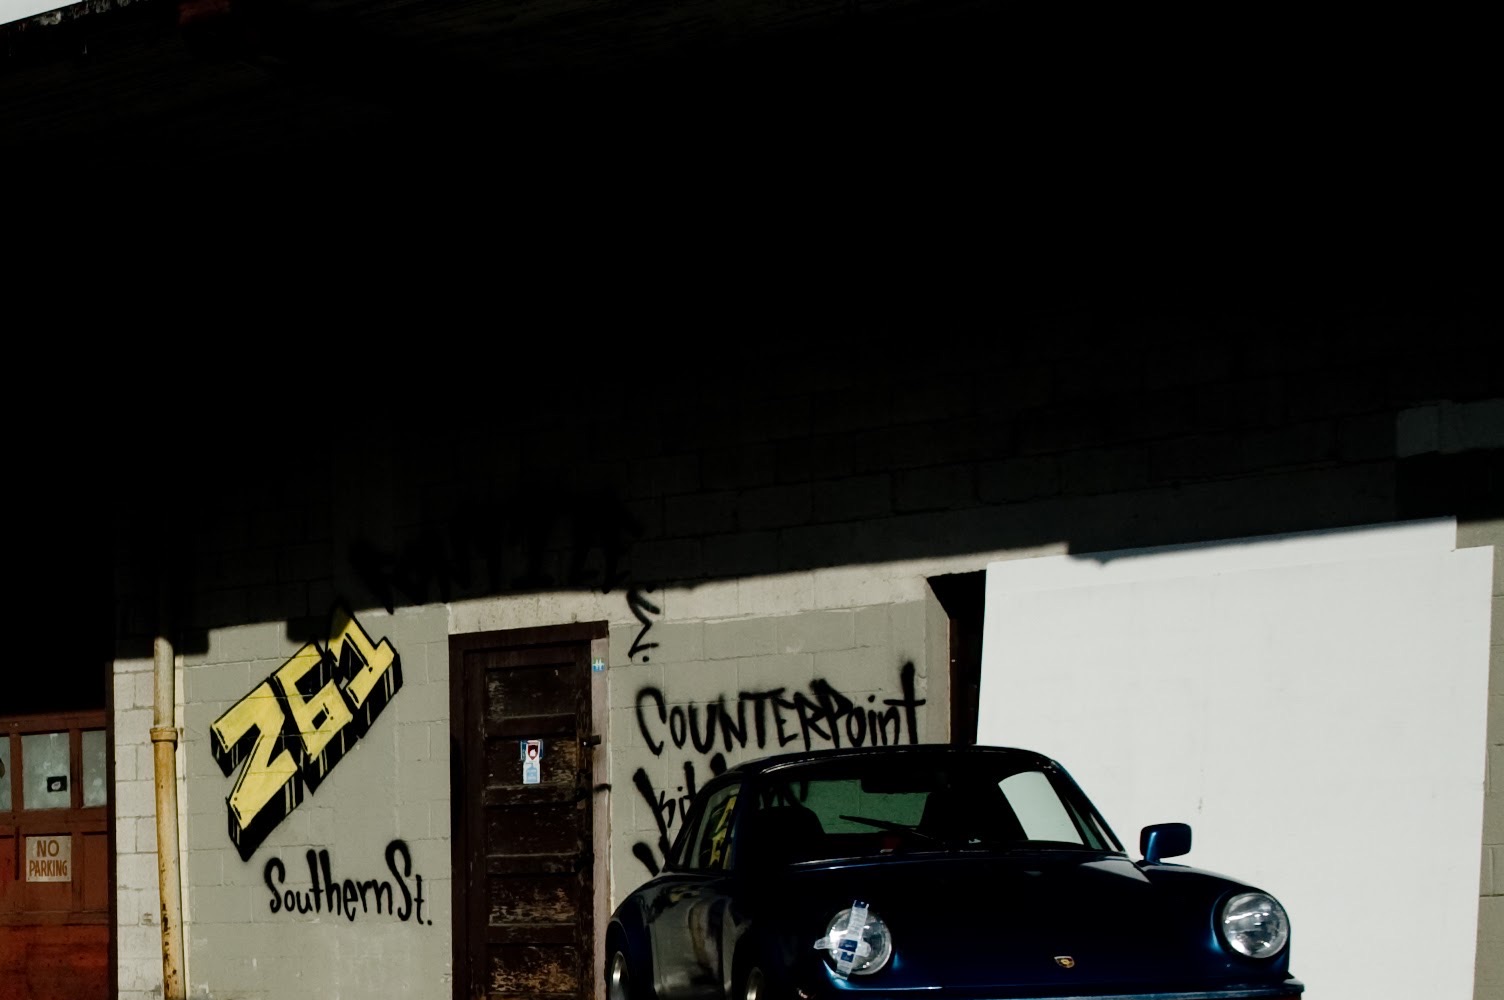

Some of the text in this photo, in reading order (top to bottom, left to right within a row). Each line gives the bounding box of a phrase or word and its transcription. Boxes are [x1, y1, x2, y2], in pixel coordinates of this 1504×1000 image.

[210, 597, 403, 861] 261
[29, 860, 68, 877] PARKING
[37, 840, 60, 857] NO
[264, 839, 432, 925] Southern St.
